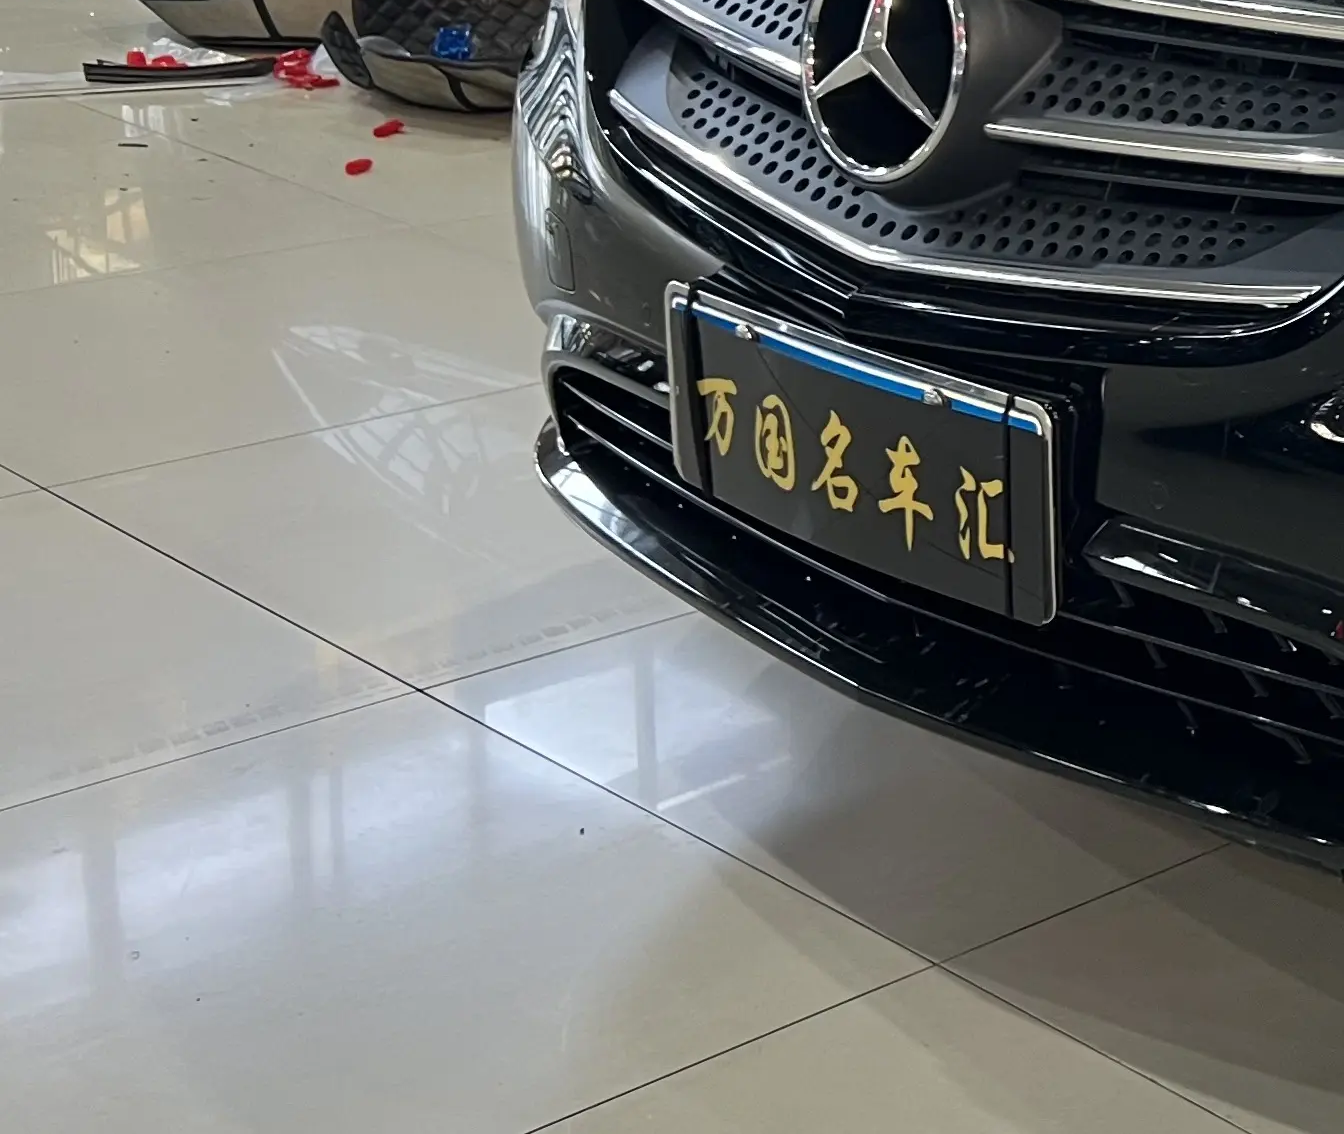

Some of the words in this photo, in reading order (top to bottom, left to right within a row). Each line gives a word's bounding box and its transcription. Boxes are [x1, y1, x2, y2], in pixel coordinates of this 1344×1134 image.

[698, 378, 1015, 563] 万国名车汇
